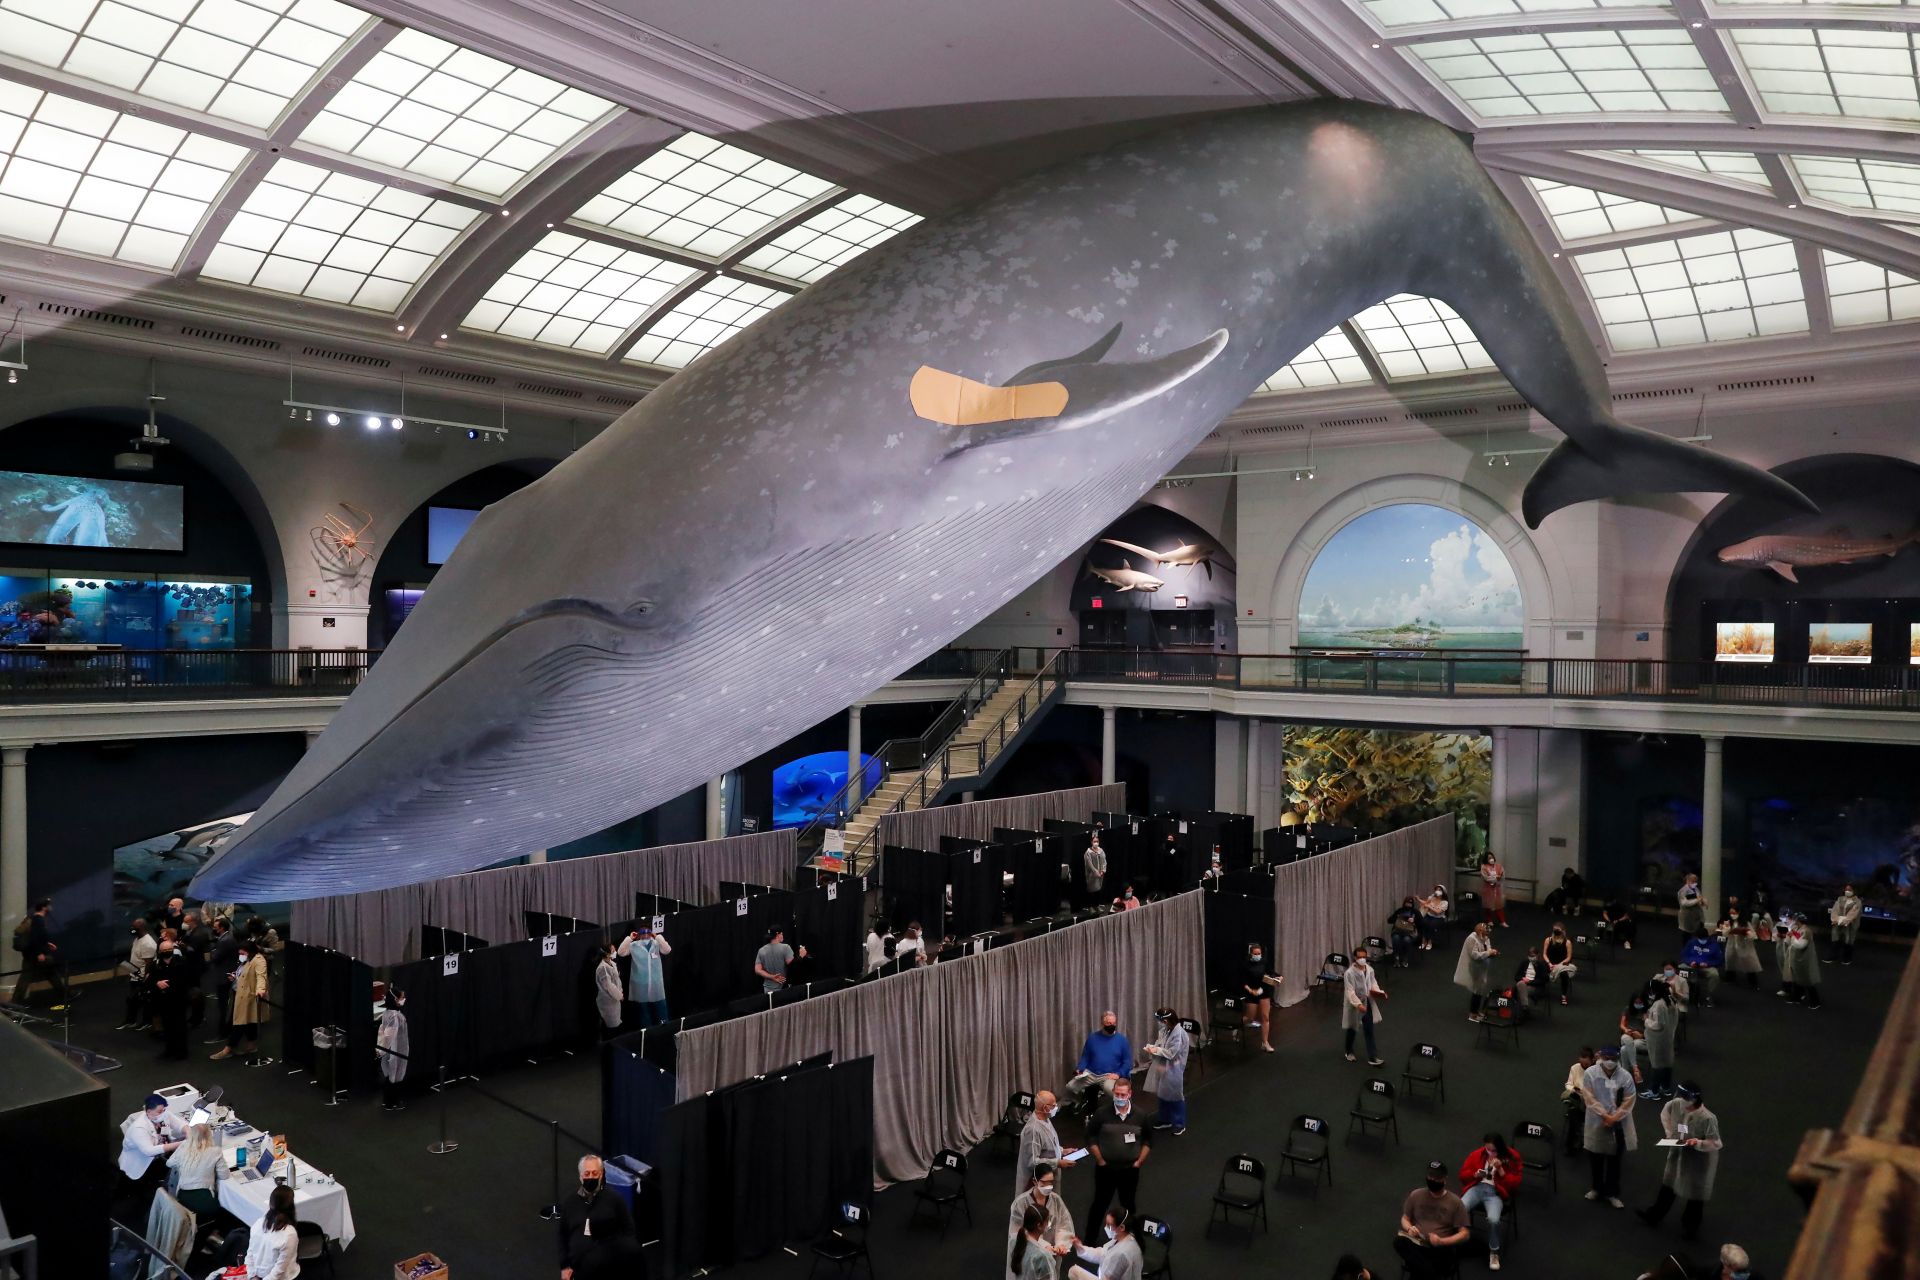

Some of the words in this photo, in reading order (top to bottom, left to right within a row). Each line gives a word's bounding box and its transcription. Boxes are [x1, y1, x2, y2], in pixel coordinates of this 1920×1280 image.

[828, 888, 836, 896] 11
[737, 903, 747, 911] 13
[653, 920, 663, 929] 15
[544, 942, 555, 951] 17
[445, 961, 457, 970] 19
[1375, 1084, 1384, 1092] 18
[1306, 1122, 1315, 1130] 14
[1529, 1128, 1541, 1136] 19
[949, 1159, 954, 1167] 5
[1240, 1163, 1252, 1171] 10
[1147, 1225, 1154, 1234] 6
